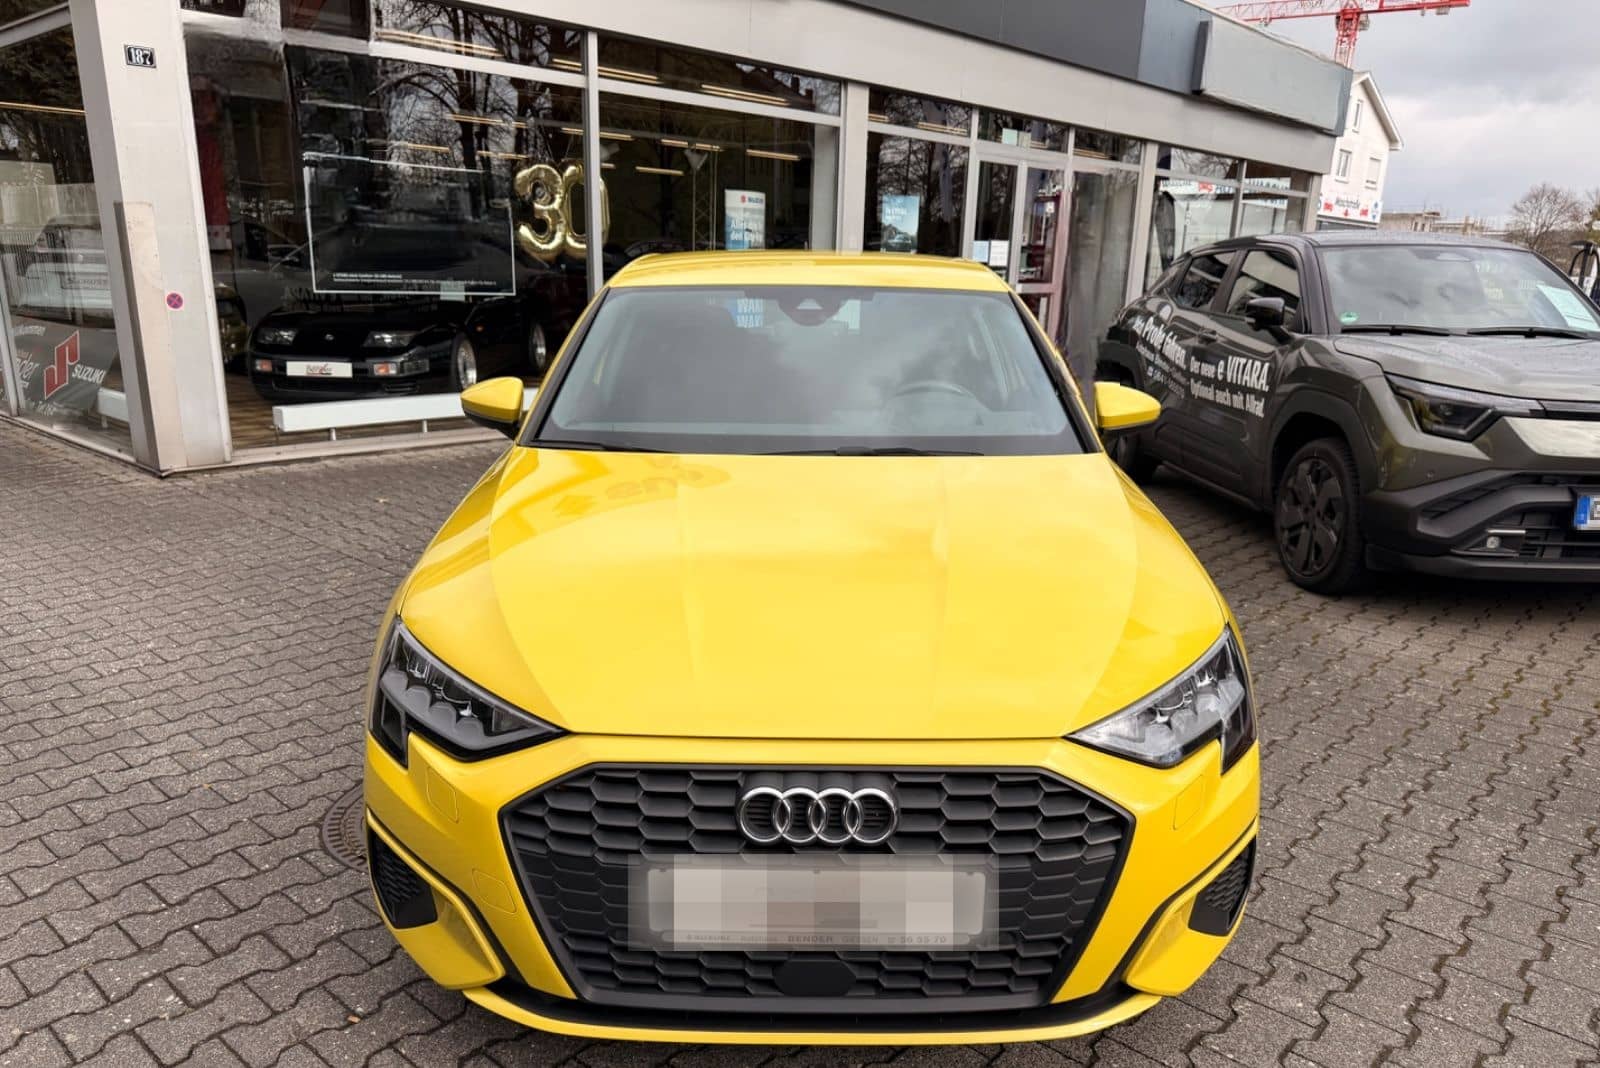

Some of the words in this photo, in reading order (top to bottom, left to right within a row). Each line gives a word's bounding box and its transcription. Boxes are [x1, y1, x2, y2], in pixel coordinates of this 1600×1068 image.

[130, 48, 151, 65] 187
[514, 163, 610, 261] 30
[72, 364, 106, 384] SUZUKI
[1217, 360, 1226, 381] e
[1226, 355, 1270, 392] VITARA.
[787, 935, 833, 943] BENDER
